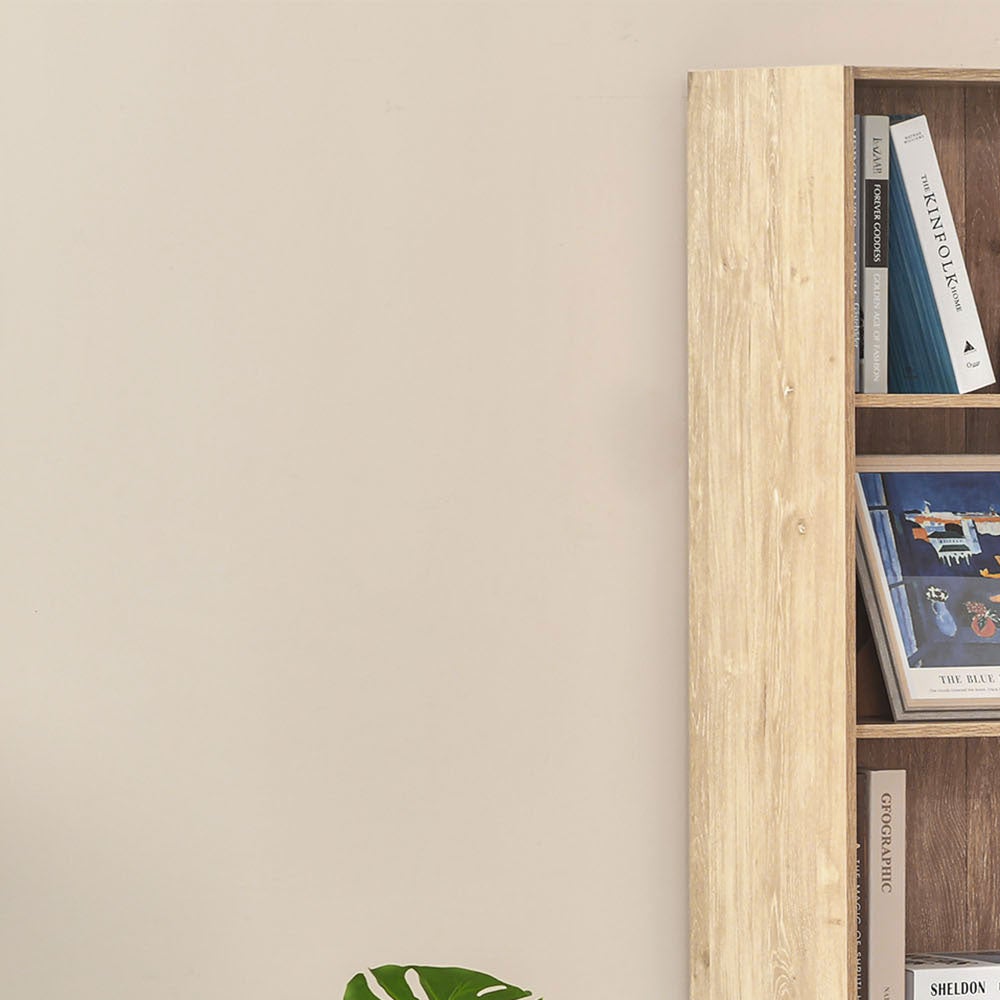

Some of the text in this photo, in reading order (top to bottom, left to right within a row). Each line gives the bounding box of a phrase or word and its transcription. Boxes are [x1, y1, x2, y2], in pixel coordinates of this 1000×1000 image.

[873, 184, 882, 263] FOREVER GODDESS
[921, 174, 962, 312] THE KINFOLK HOME
[939, 674, 963, 685] THE
[966, 674, 996, 684] BLUE
[930, 980, 986, 997] SHELDON
